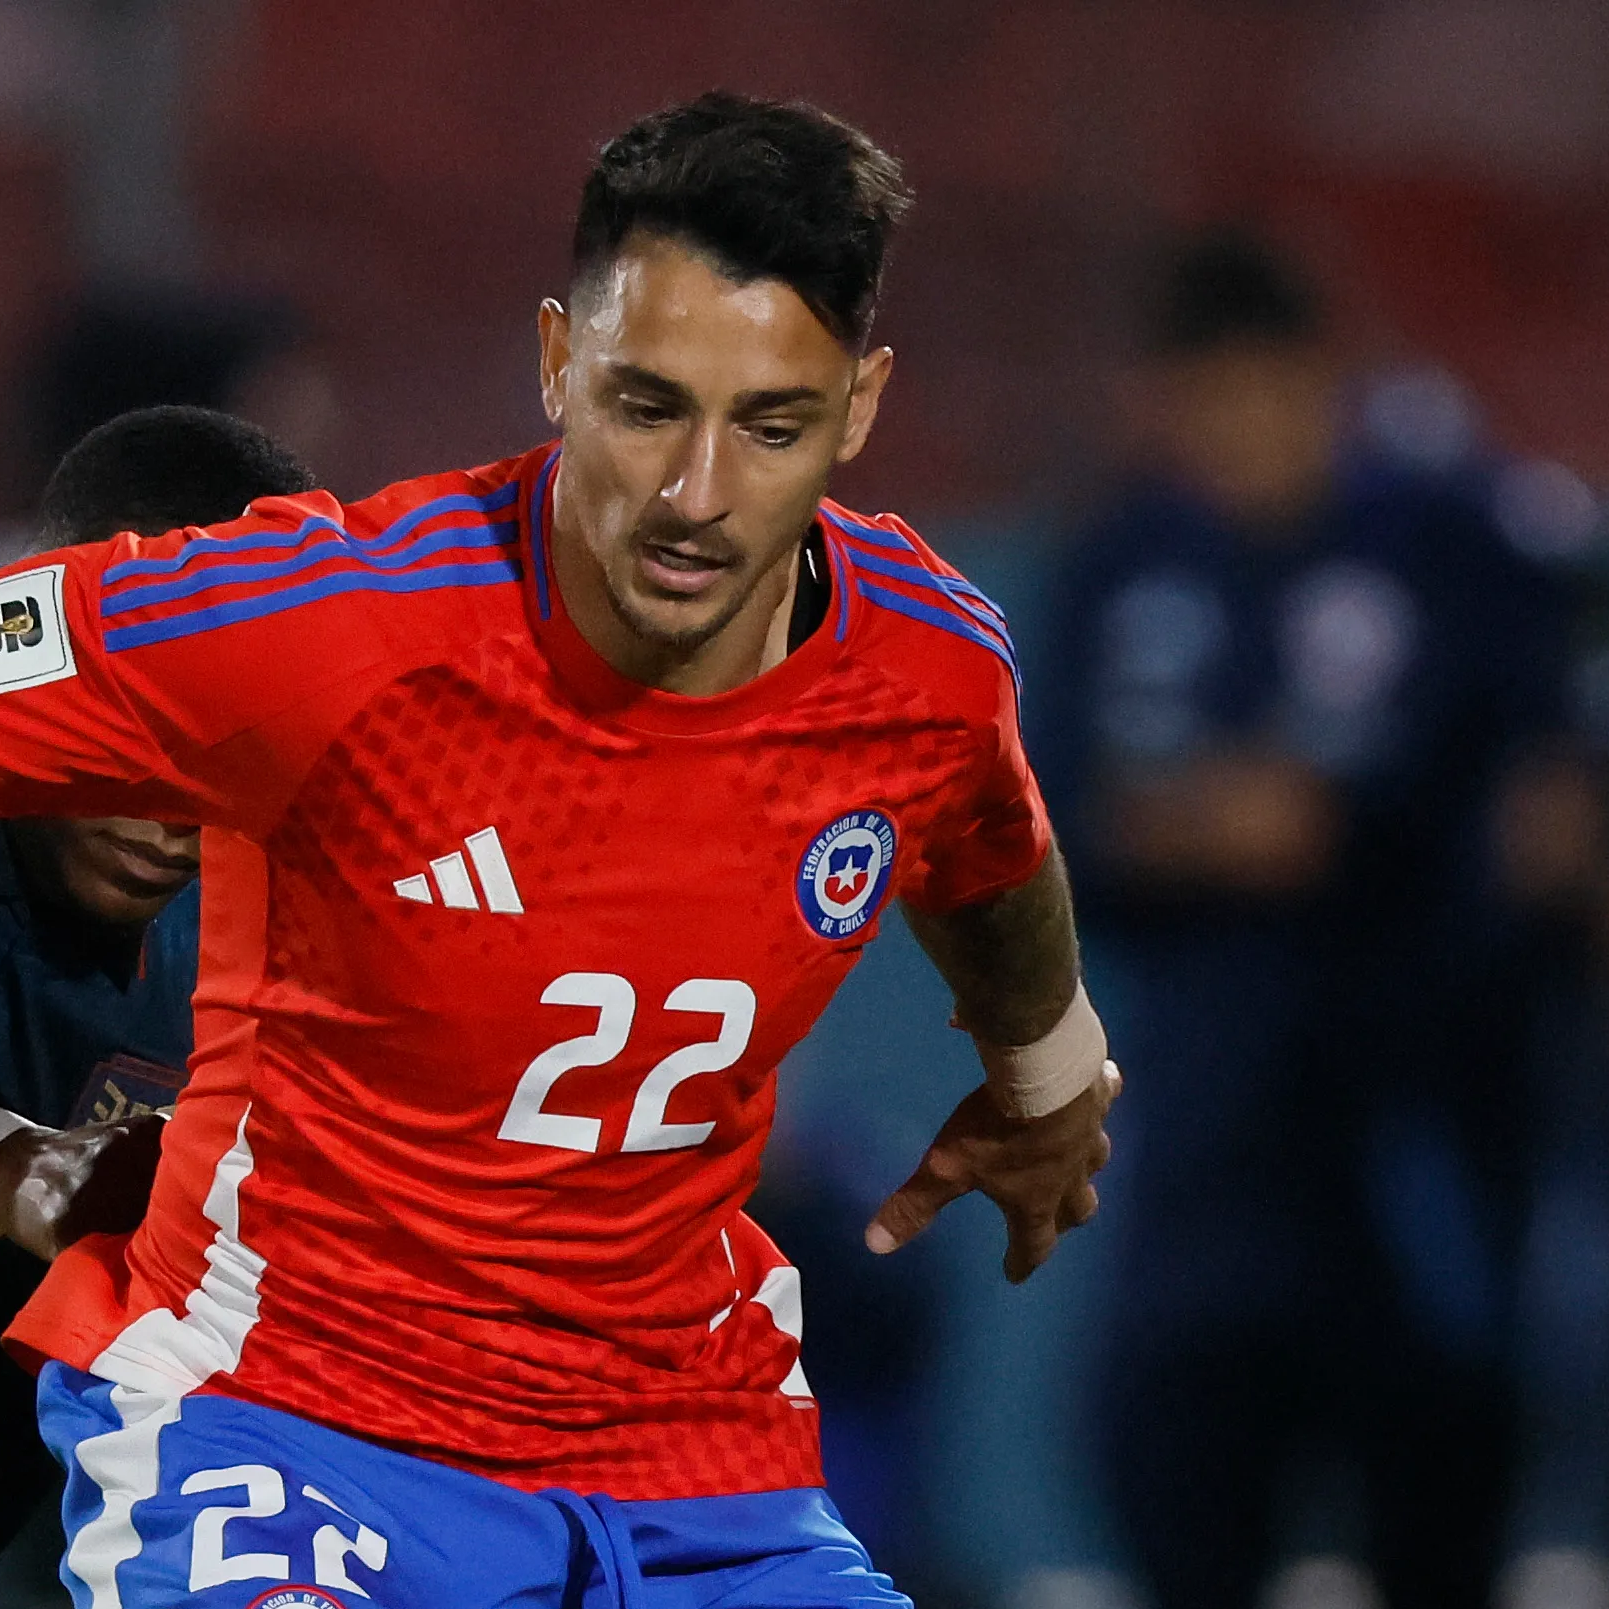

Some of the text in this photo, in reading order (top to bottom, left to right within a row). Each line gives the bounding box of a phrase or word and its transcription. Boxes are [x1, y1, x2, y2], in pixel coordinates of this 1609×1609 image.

[802, 814, 894, 881] FEDERACION DE FUTBOL
[820, 910, 866, 935] DE CHILE
[497, 972, 756, 1153] 22
[303, 1593, 318, 1605] DE
